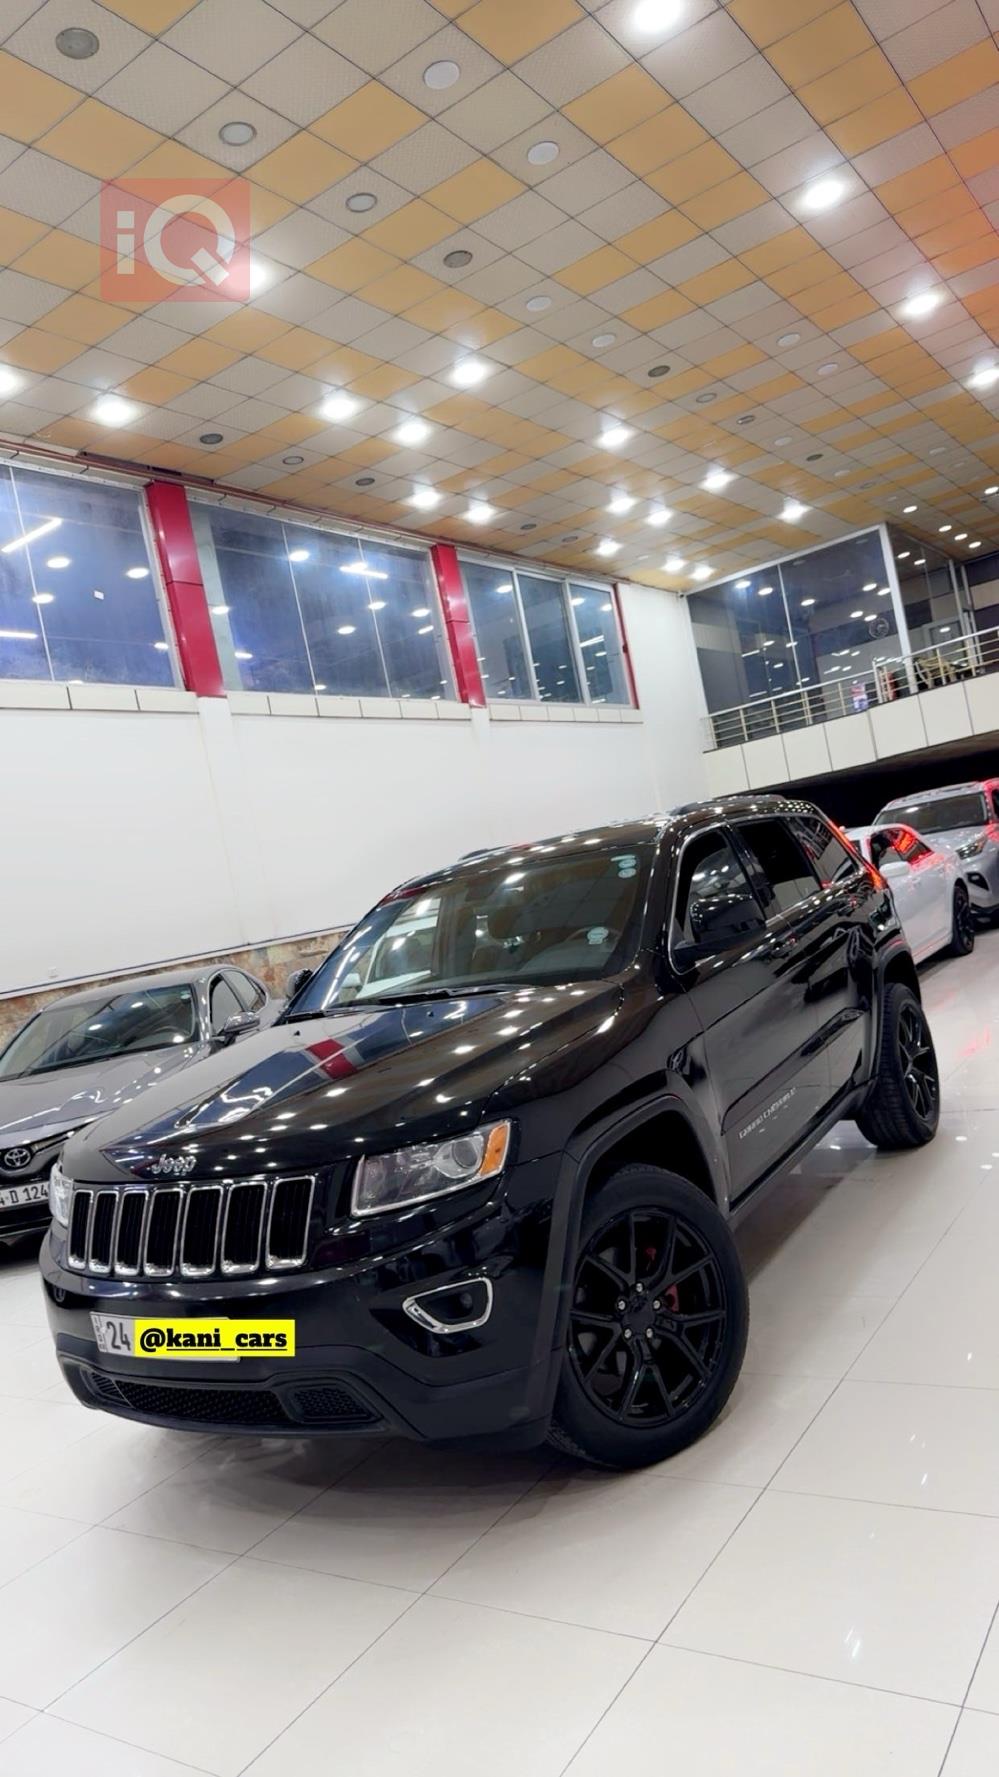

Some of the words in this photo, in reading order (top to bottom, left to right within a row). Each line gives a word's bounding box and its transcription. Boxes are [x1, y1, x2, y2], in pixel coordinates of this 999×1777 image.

[151, 1153, 197, 1176] Jeep
[22, 1184, 50, 1201] 124
[106, 1321, 132, 1351] 24
